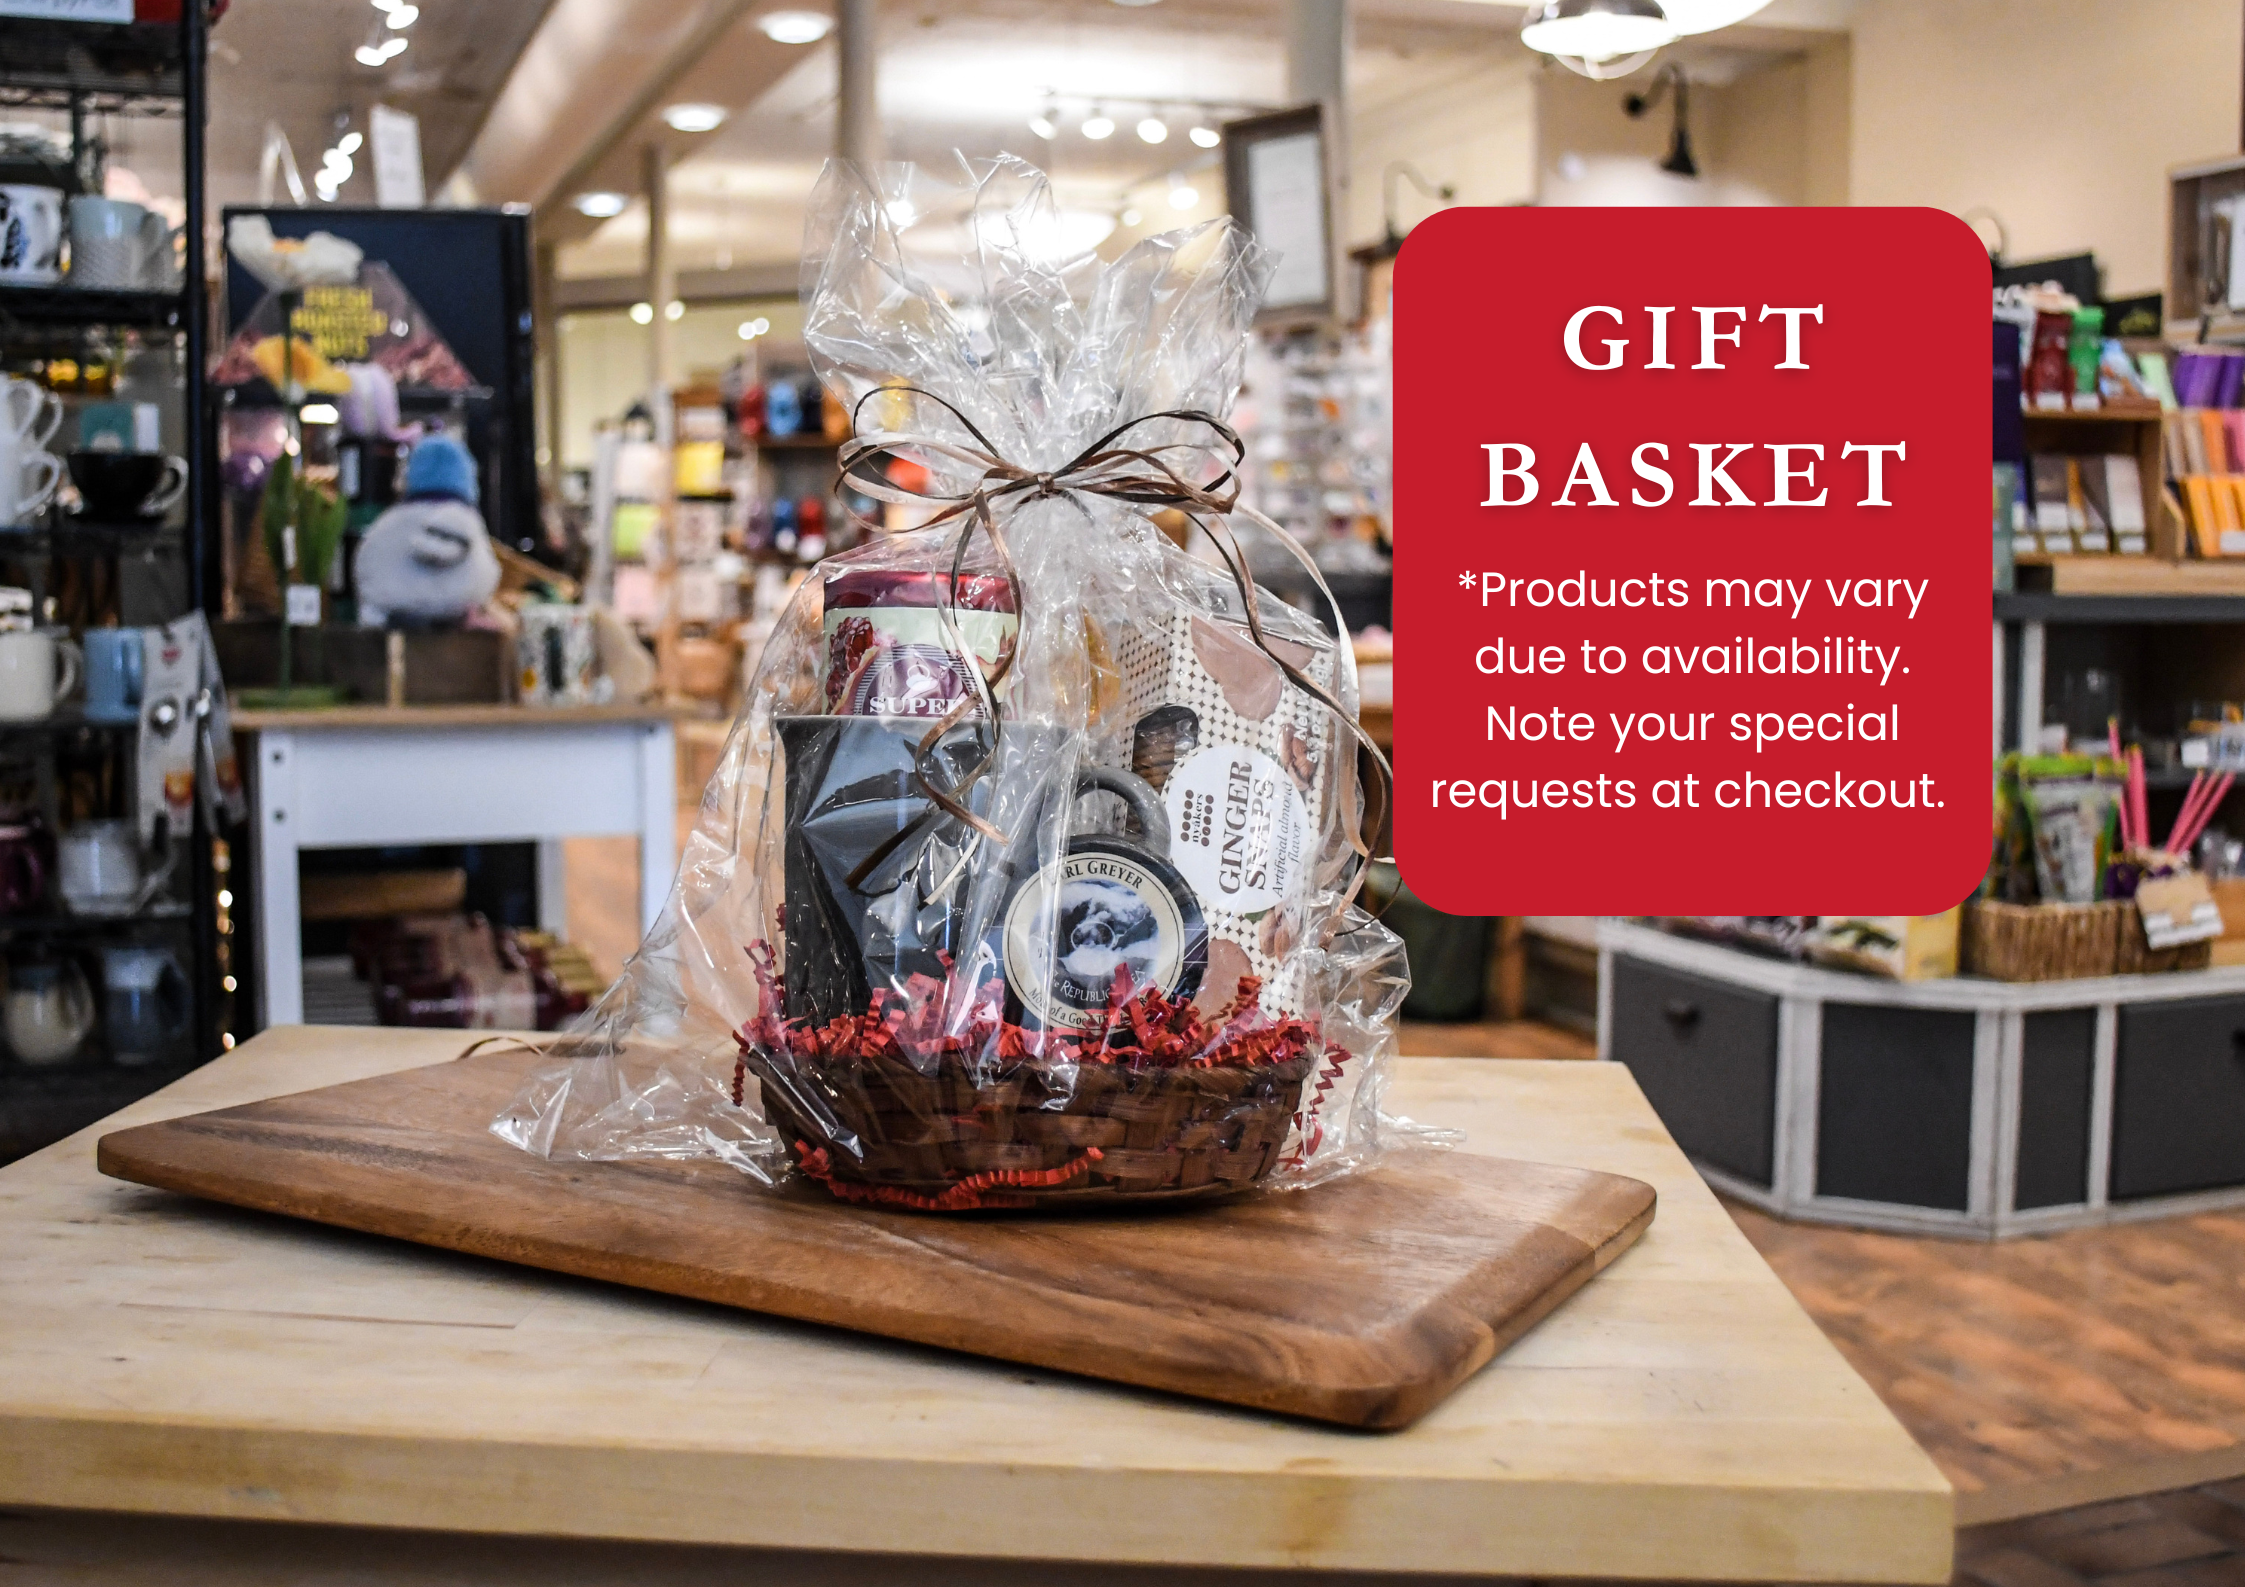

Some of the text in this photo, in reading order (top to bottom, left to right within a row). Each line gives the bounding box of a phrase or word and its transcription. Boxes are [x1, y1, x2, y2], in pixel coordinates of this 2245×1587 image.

[1087, 860, 1143, 889] GREYER
[1218, 761, 1252, 894] GINGER
[1245, 779, 1274, 891] SNAPS
[1272, 782, 1293, 899] Artificial almond
[1290, 821, 1302, 864] flavor
